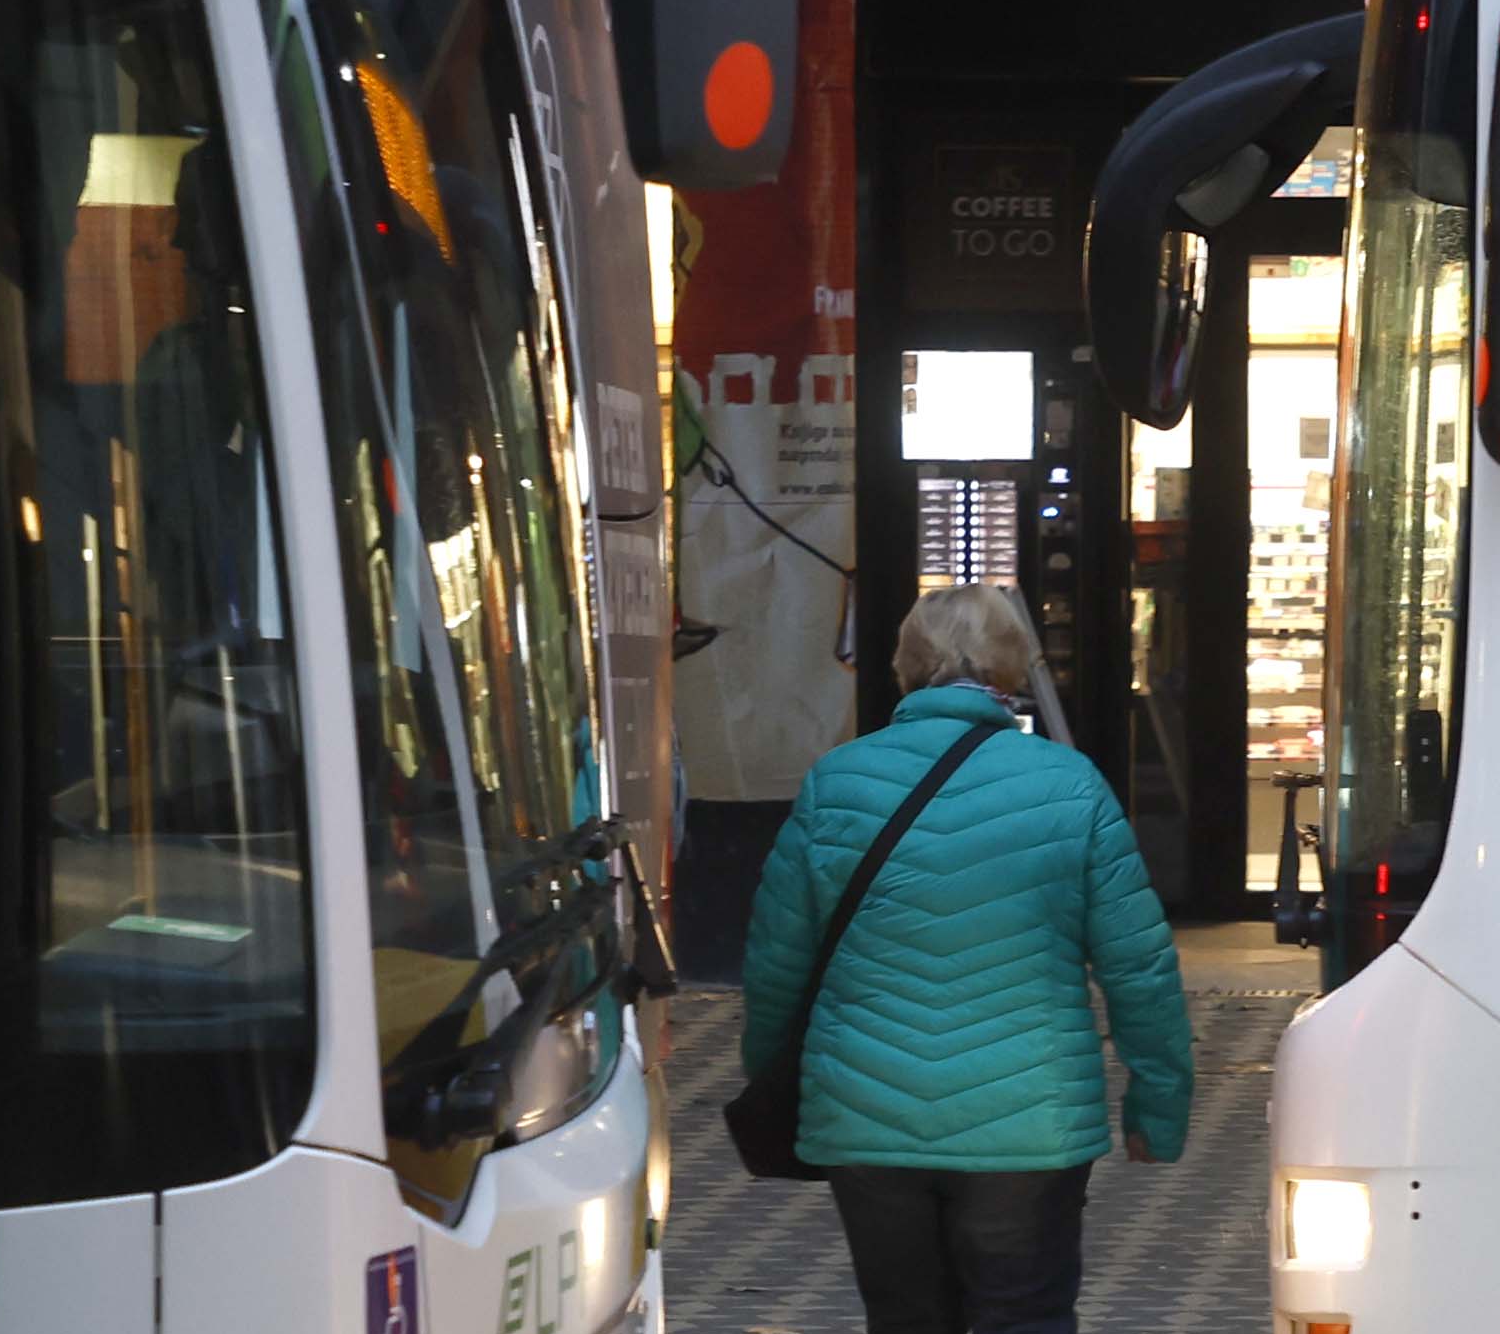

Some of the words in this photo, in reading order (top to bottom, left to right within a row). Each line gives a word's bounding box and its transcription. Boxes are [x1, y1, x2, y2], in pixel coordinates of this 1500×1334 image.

[952, 196, 1053, 217] COFFEE
[950, 229, 996, 256] TO
[1003, 229, 1055, 256] GO
